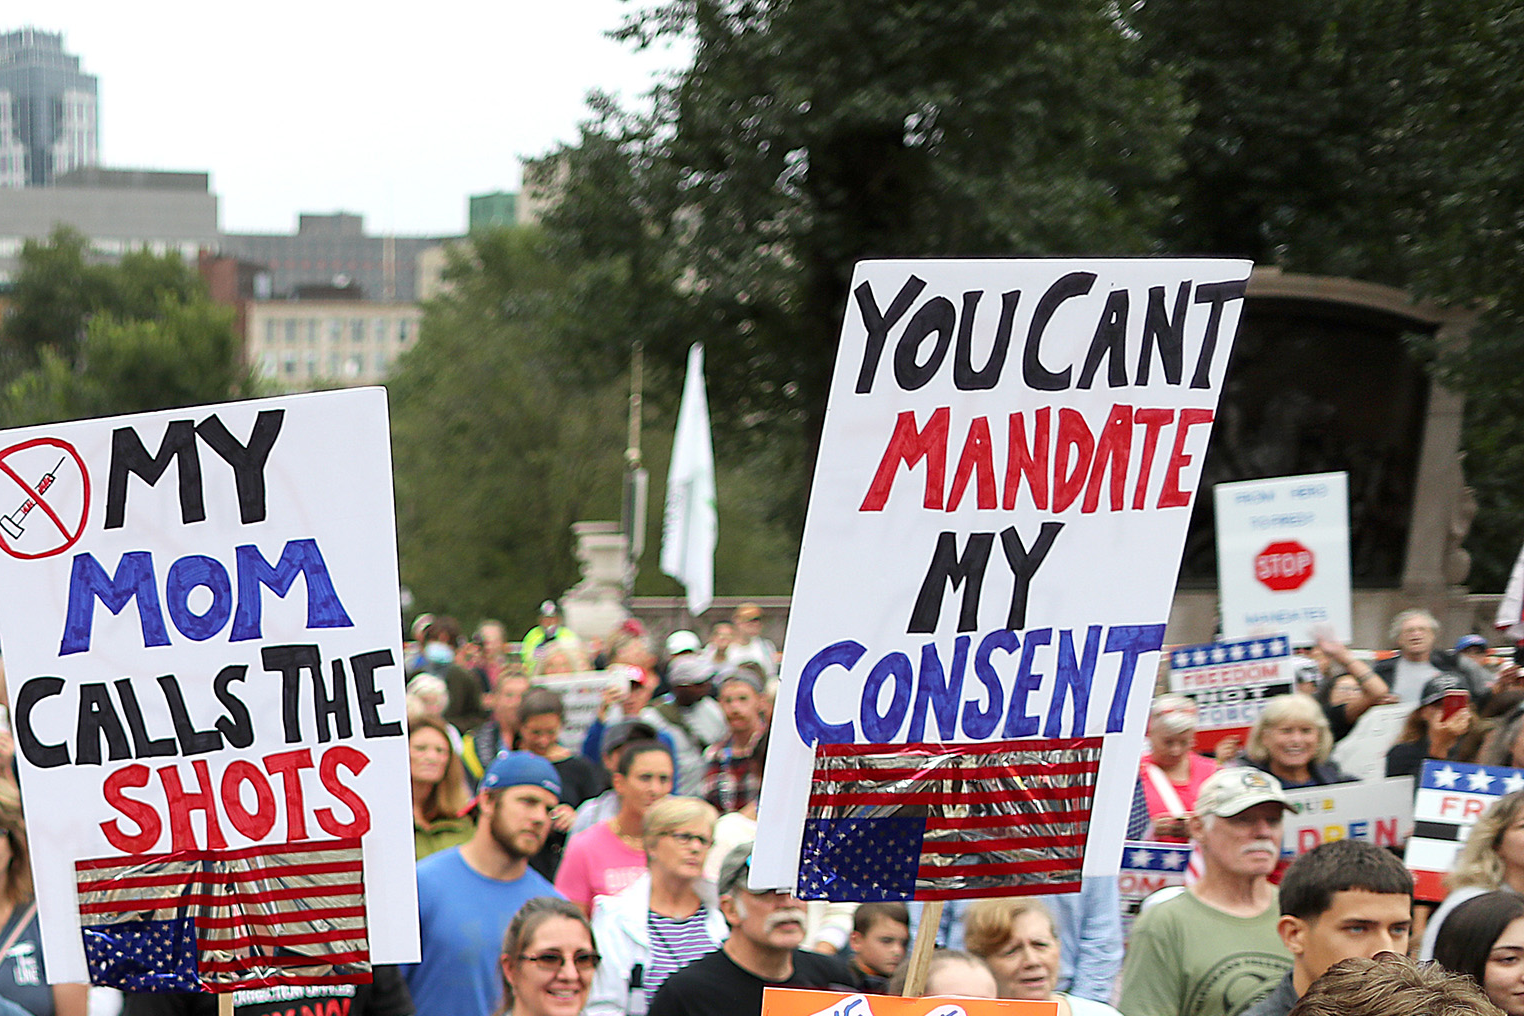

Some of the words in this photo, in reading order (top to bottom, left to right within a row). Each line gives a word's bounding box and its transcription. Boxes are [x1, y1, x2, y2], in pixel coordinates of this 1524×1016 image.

[854, 275, 1021, 394] YOU
[1022, 272, 1249, 390] CANT
[104, 409, 285, 529] MY
[858, 405, 1214, 513] MANDATE
[58, 538, 354, 657] MOM
[906, 522, 1064, 634] MY
[1256, 551, 1311, 580] STOP
[15, 664, 255, 768] CALLS
[261, 644, 403, 743] THE
[795, 624, 1166, 748] CONSENT
[1183, 664, 1280, 686] FREEDOM
[1196, 686, 1270, 702] NOT
[1198, 703, 1266, 723] FORC
[99, 745, 371, 854] SHOTS
